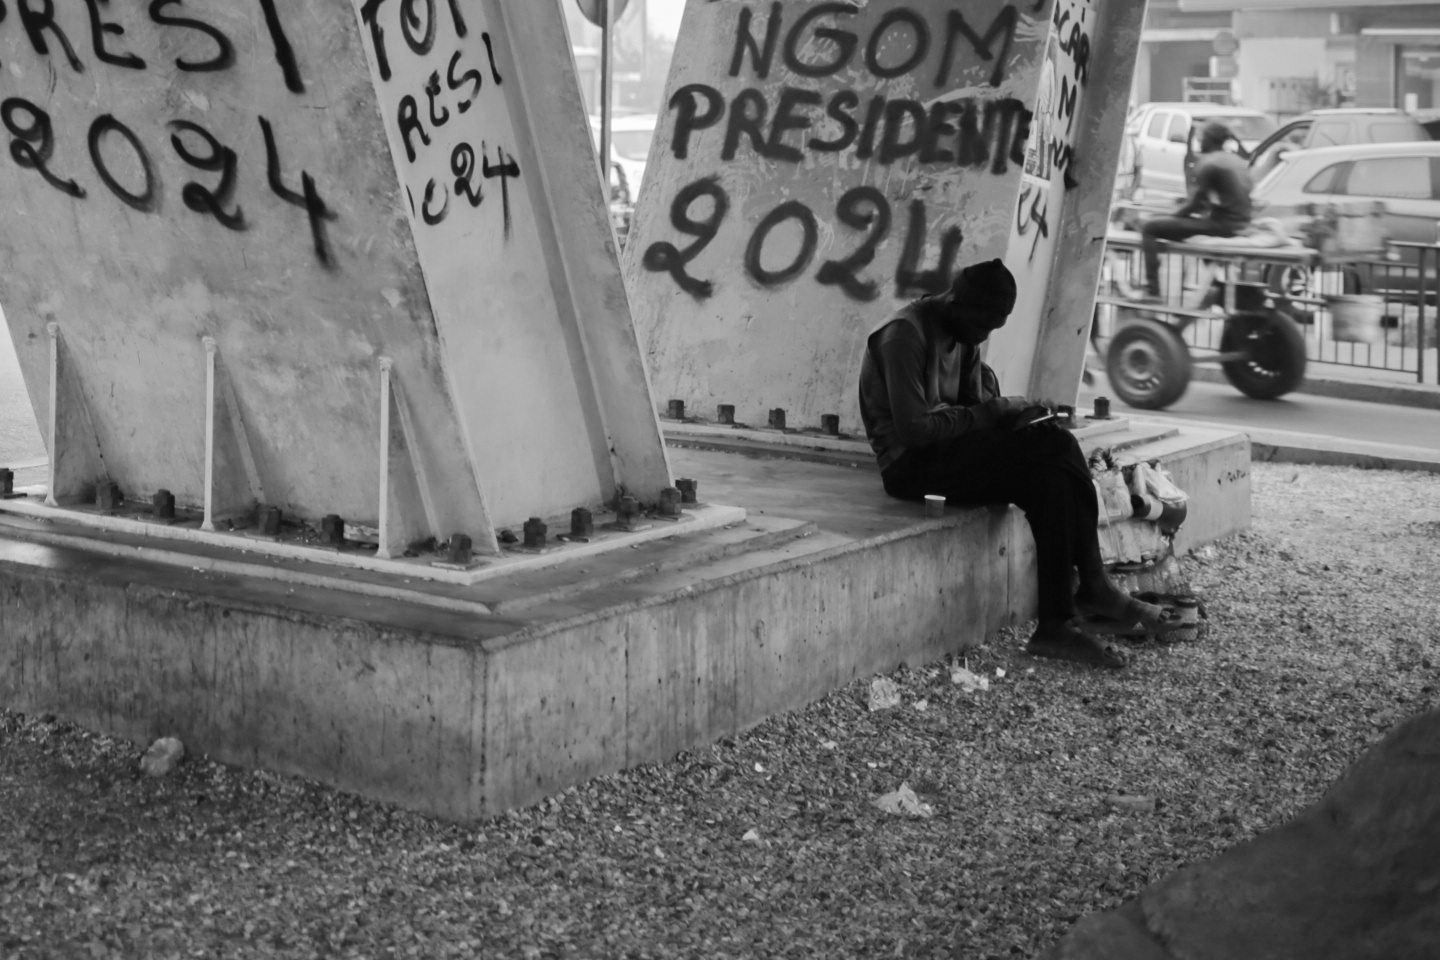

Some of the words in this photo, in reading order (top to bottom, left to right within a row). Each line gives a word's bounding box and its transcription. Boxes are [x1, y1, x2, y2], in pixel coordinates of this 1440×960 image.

[728, 1, 1018, 87] NGOM
[0, 97, 340, 273] 2024
[642, 174, 964, 302] 2024
